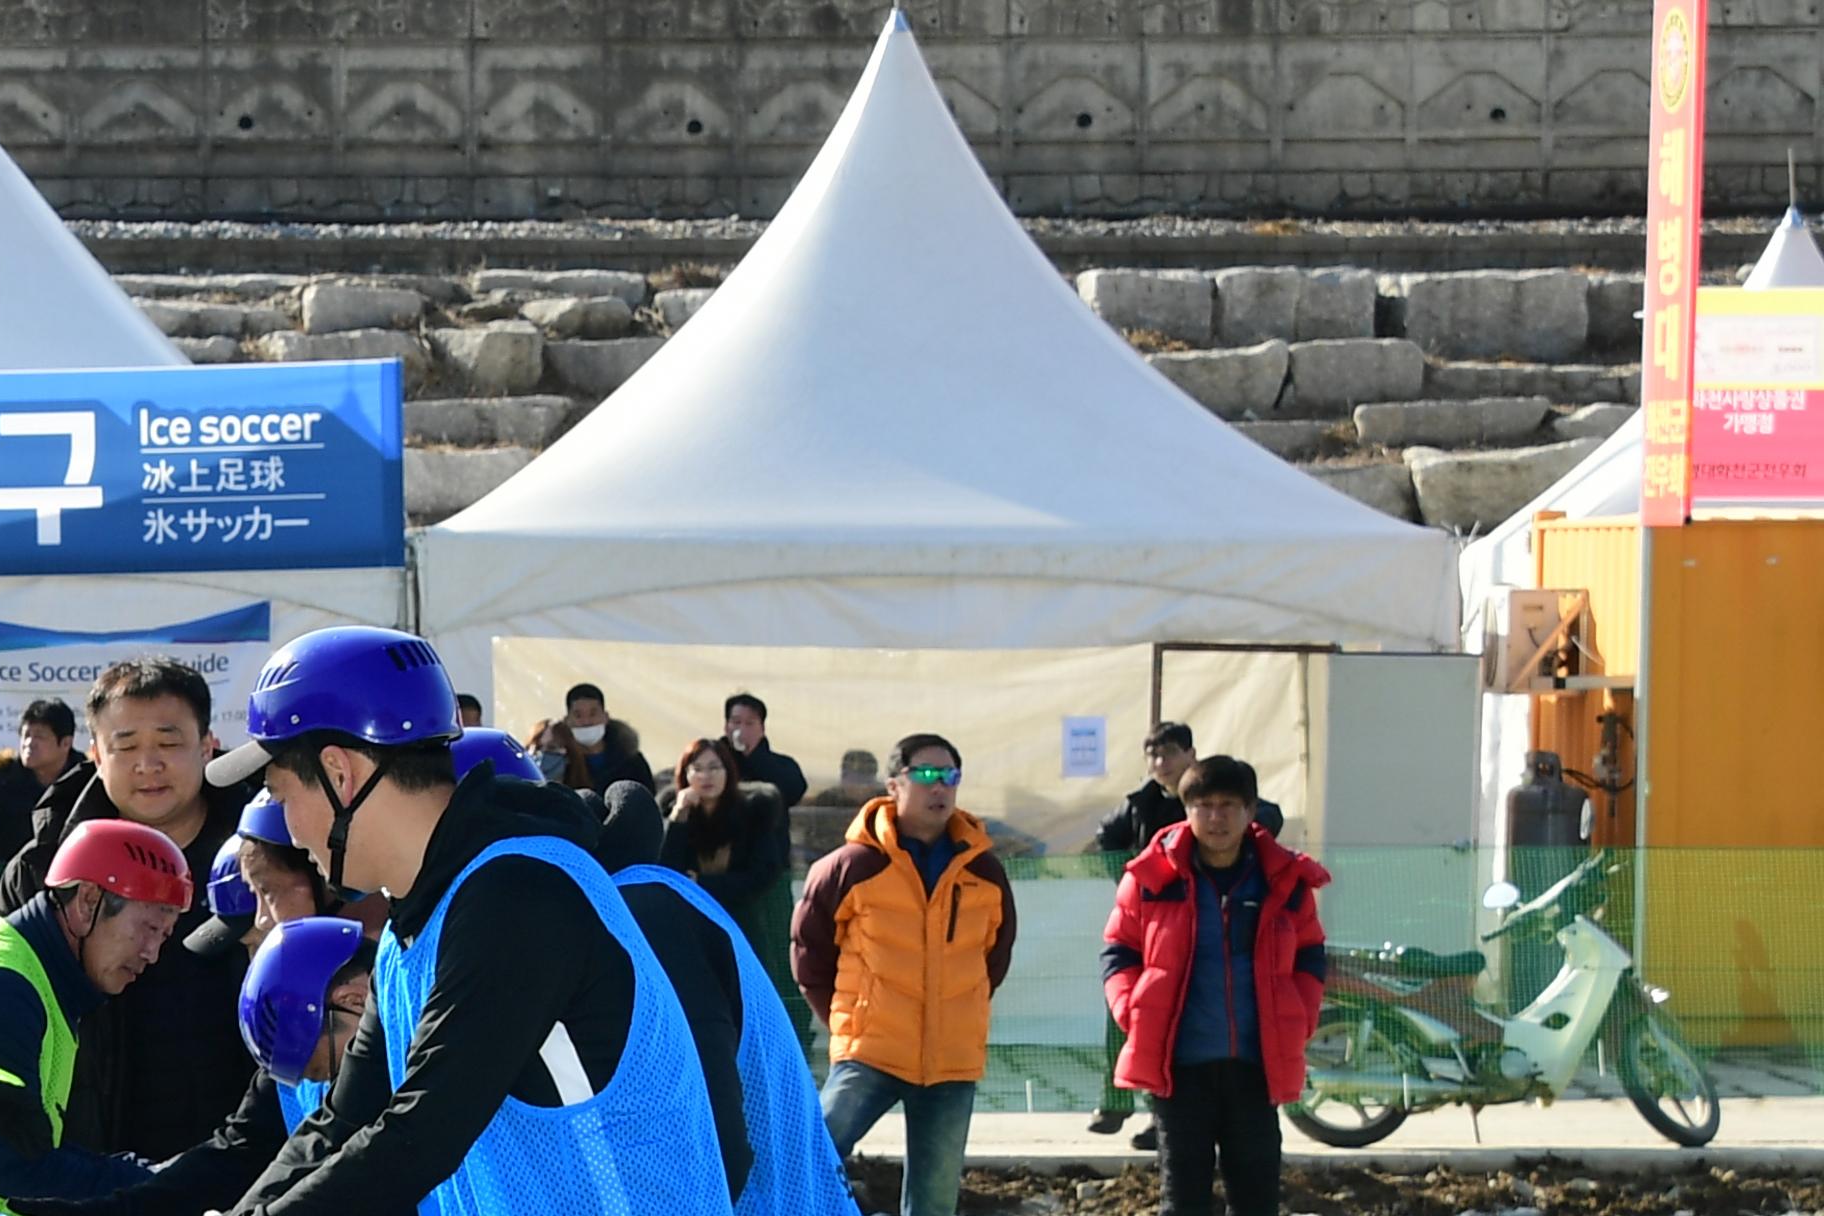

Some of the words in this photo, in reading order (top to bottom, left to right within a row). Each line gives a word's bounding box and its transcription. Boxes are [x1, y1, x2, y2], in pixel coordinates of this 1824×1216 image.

[139, 408, 192, 446] Ice
[199, 412, 322, 445] soccer
[142, 455, 286, 495] 冰上足球
[142, 506, 311, 545] 氷サッカー
[28, 661, 100, 682] Soccer
